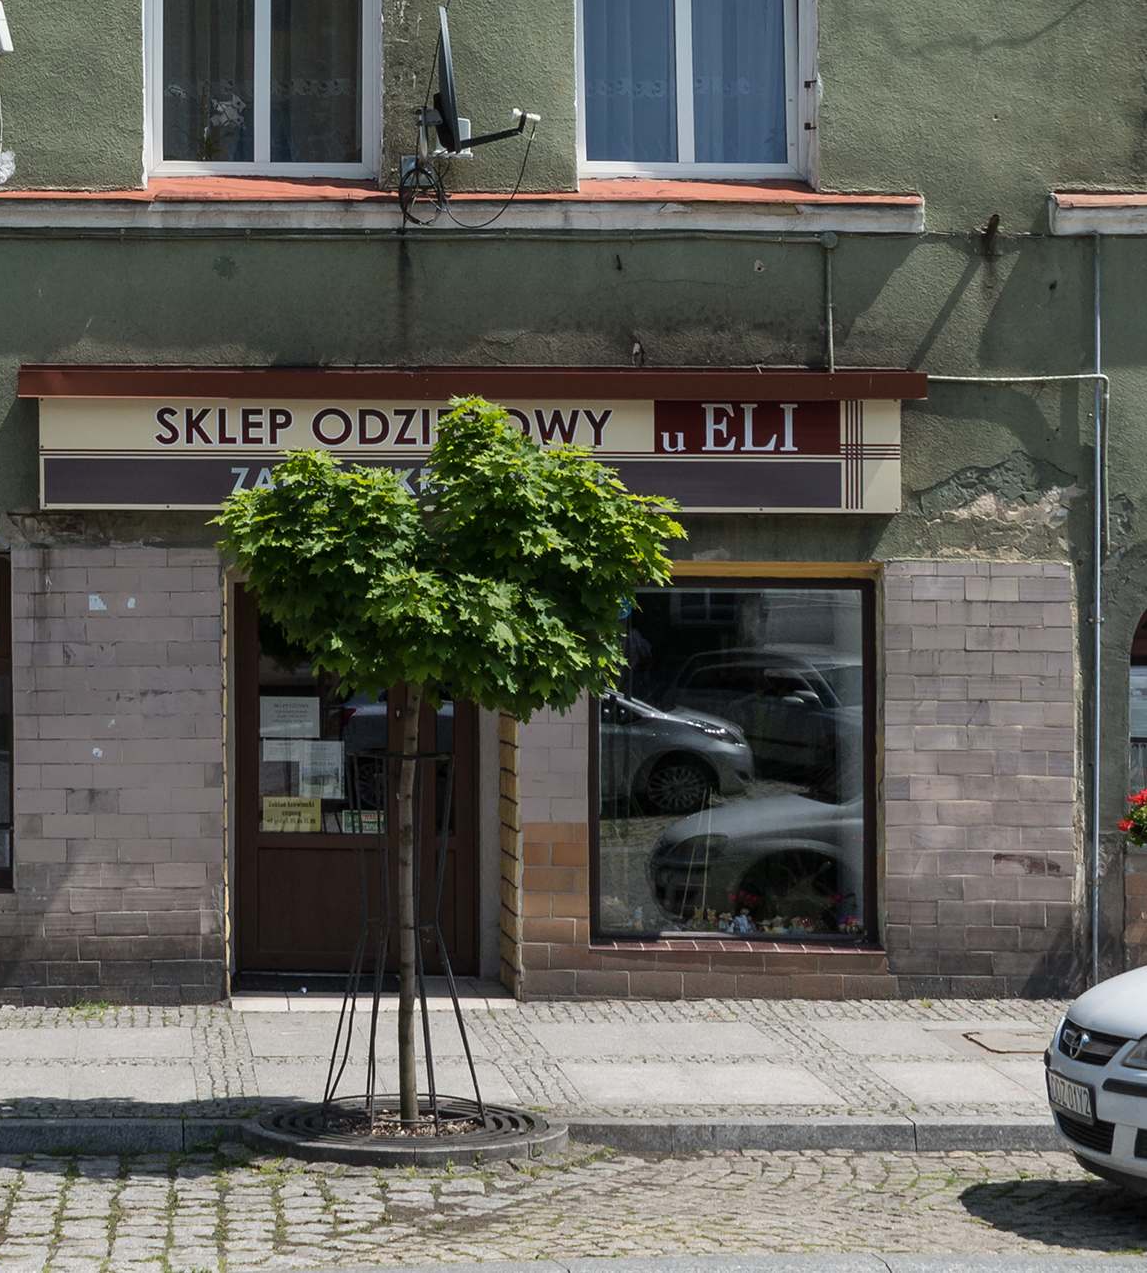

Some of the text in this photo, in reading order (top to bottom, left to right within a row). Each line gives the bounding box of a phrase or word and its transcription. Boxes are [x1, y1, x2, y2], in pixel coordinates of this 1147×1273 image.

[154, 407, 294, 446] SKLEP
[660, 403, 799, 453] u ELI
